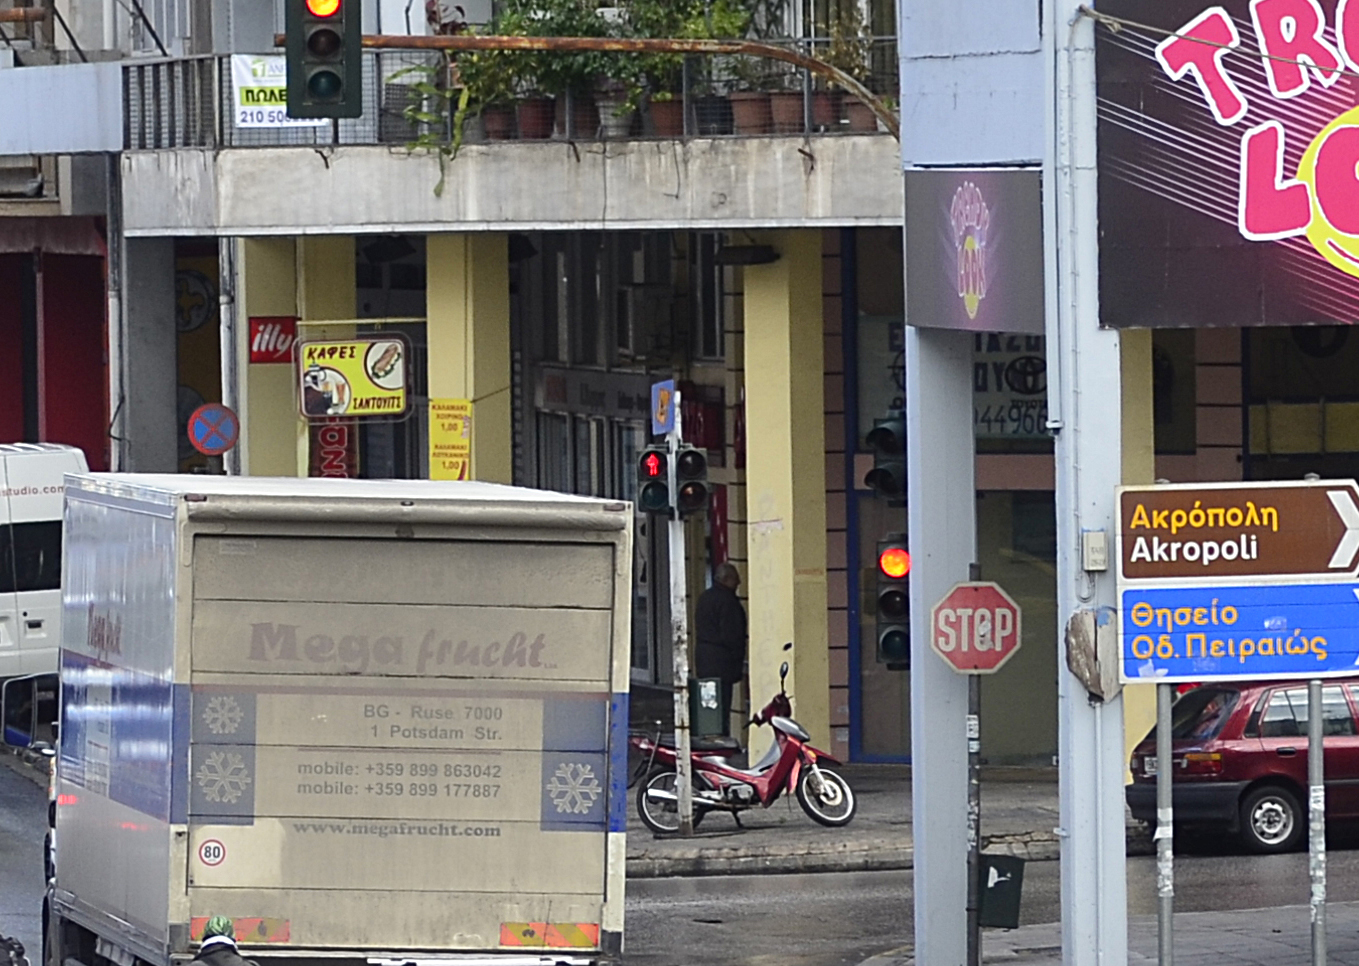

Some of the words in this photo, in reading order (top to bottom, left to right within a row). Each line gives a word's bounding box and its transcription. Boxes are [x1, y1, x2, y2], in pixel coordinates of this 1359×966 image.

[240, 111, 264, 123] 210
[252, 323, 292, 357] illy
[307, 346, 356, 360] ΚΑΦΕΣ
[1130, 501, 1279, 535] Ακρόπολη
[1130, 534, 1258, 565] Akropoli
[1130, 598, 1239, 634] Θησείο
[937, 608, 1013, 652] STOP
[246, 622, 403, 673] Mega
[415, 630, 546, 673] frucht
[1131, 633, 1180, 660] Οδ.
[1186, 628, 1328, 664] Πειραιώς
[364, 704, 389, 718] BG
[411, 706, 454, 720] Ruse
[464, 706, 503, 720] 7000
[371, 725, 378, 737] 1
[390, 725, 464, 739] Potsdam
[474, 726, 502, 740] Str.
[297, 761, 359, 776] mobile:
[365, 762, 404, 776] +359
[409, 763, 438, 777] 899
[444, 764, 501, 778] 863042
[297, 781, 359, 795] mobile:
[365, 782, 404, 796] +359
[409, 783, 438, 797] 899
[444, 784, 501, 798] 177887
[293, 821, 501, 838] www.megafrucht.com
[204, 845, 221, 859] 80
